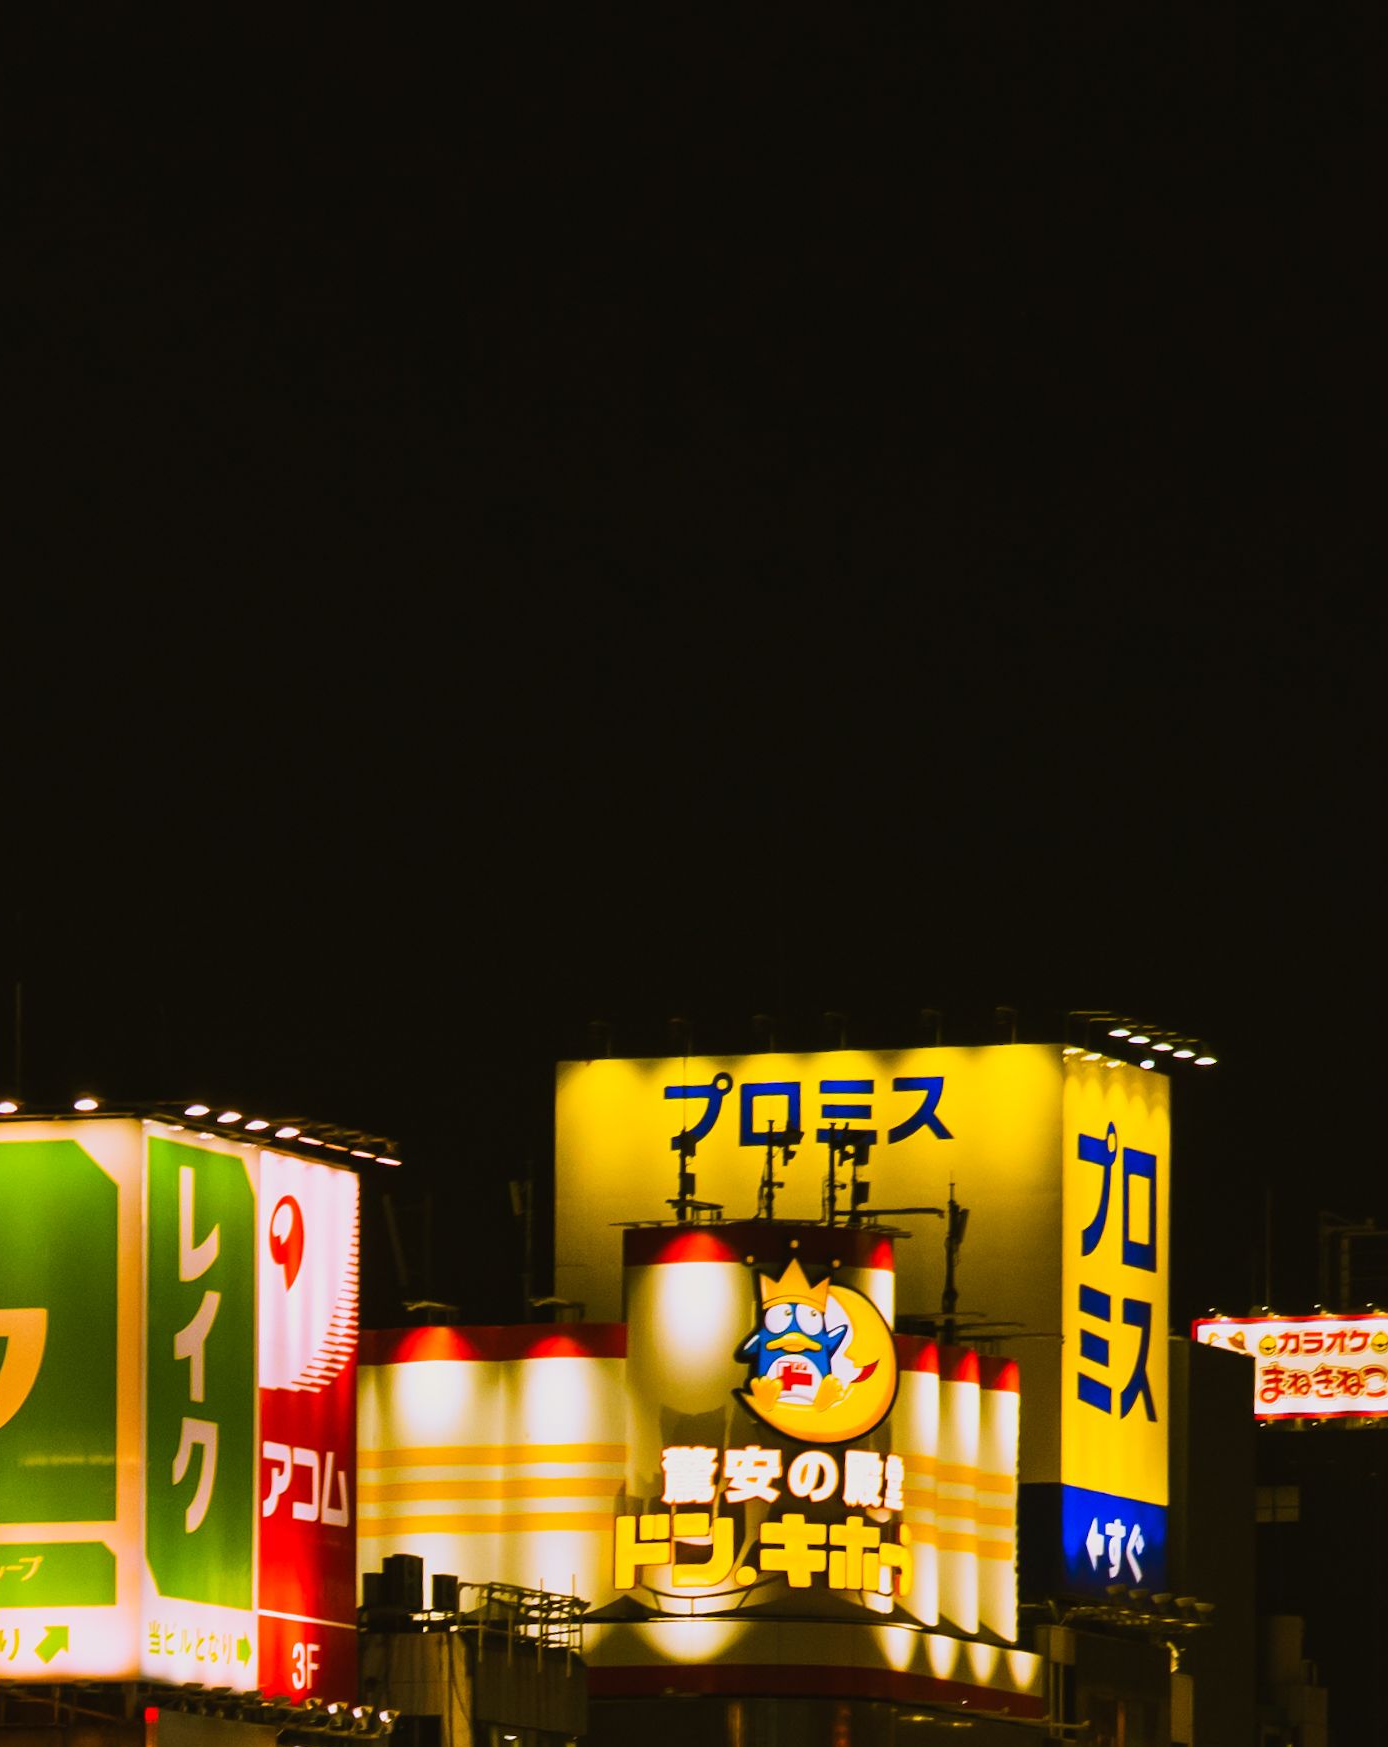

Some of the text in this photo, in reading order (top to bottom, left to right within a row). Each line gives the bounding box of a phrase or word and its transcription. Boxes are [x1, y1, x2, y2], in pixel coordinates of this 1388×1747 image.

[663, 1071, 955, 1150] プロミス
[173, 1165, 221, 1534] レイク
[1277, 1331, 1371, 1356] カラオケ
[263, 1441, 350, 1528] アコム
[1105, 1518, 1145, 1584] すぐ
[148, 1620, 236, 1665] 当ビルとなり
[292, 1643, 321, 1690] 3F
